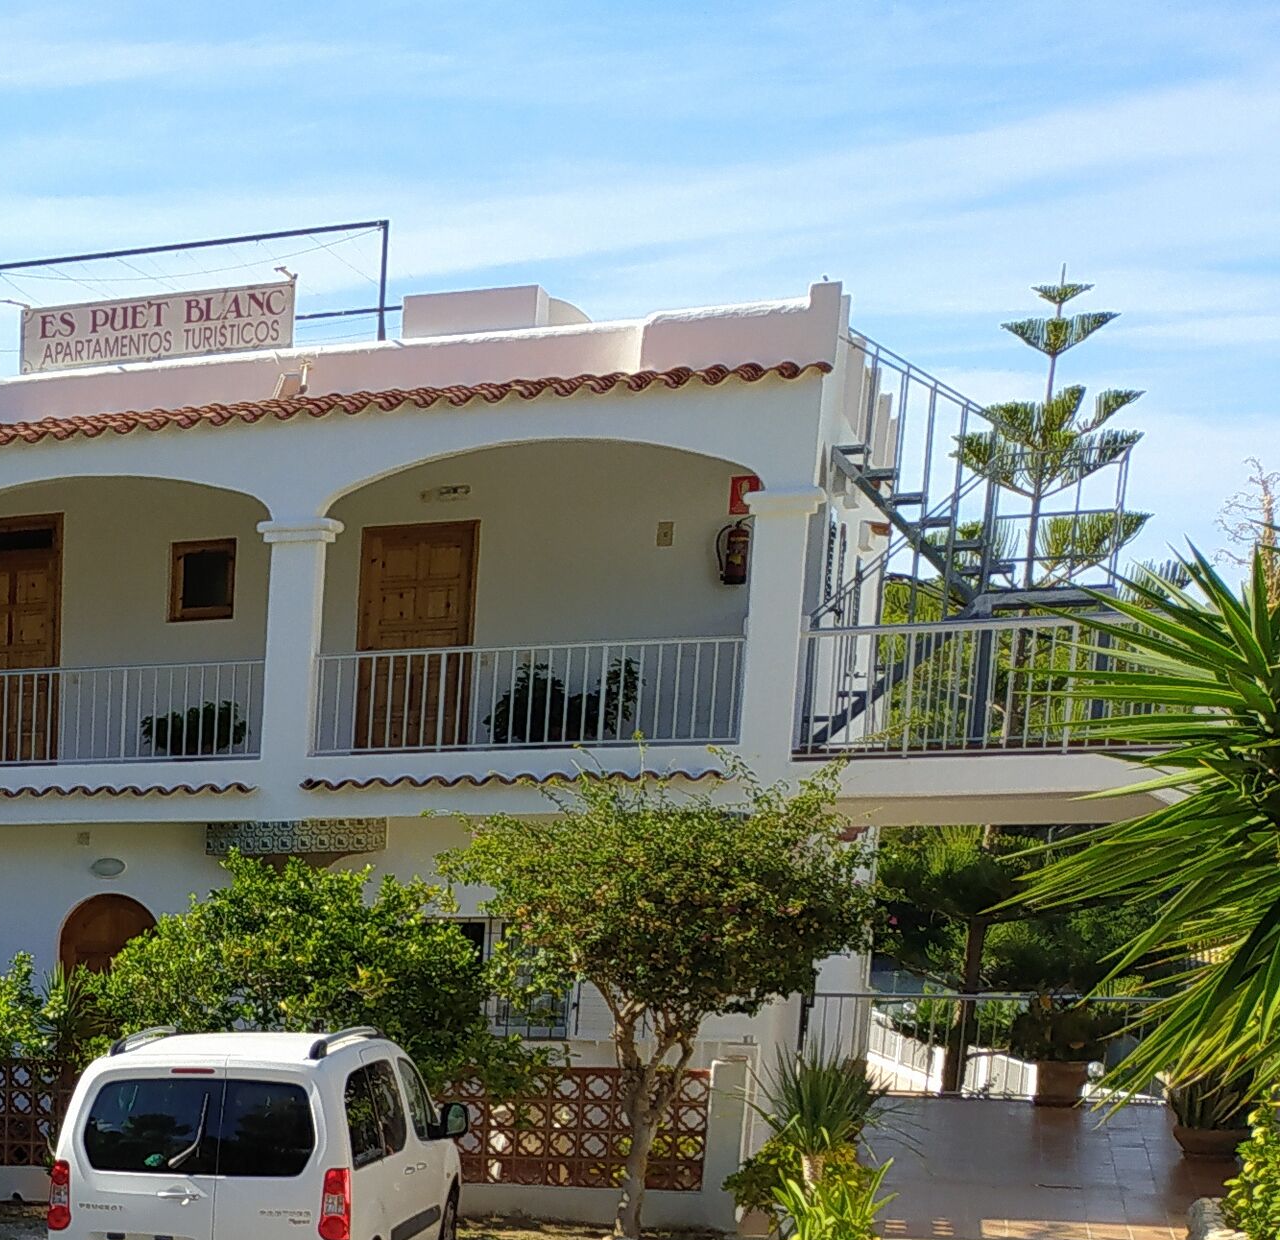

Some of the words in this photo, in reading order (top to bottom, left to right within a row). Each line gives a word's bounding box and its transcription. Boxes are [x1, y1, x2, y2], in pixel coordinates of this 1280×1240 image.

[40, 312, 76, 339] ES
[90, 301, 170, 334] PUET
[184, 290, 286, 324] BLANC
[42, 331, 172, 364] APARTAMENTOS
